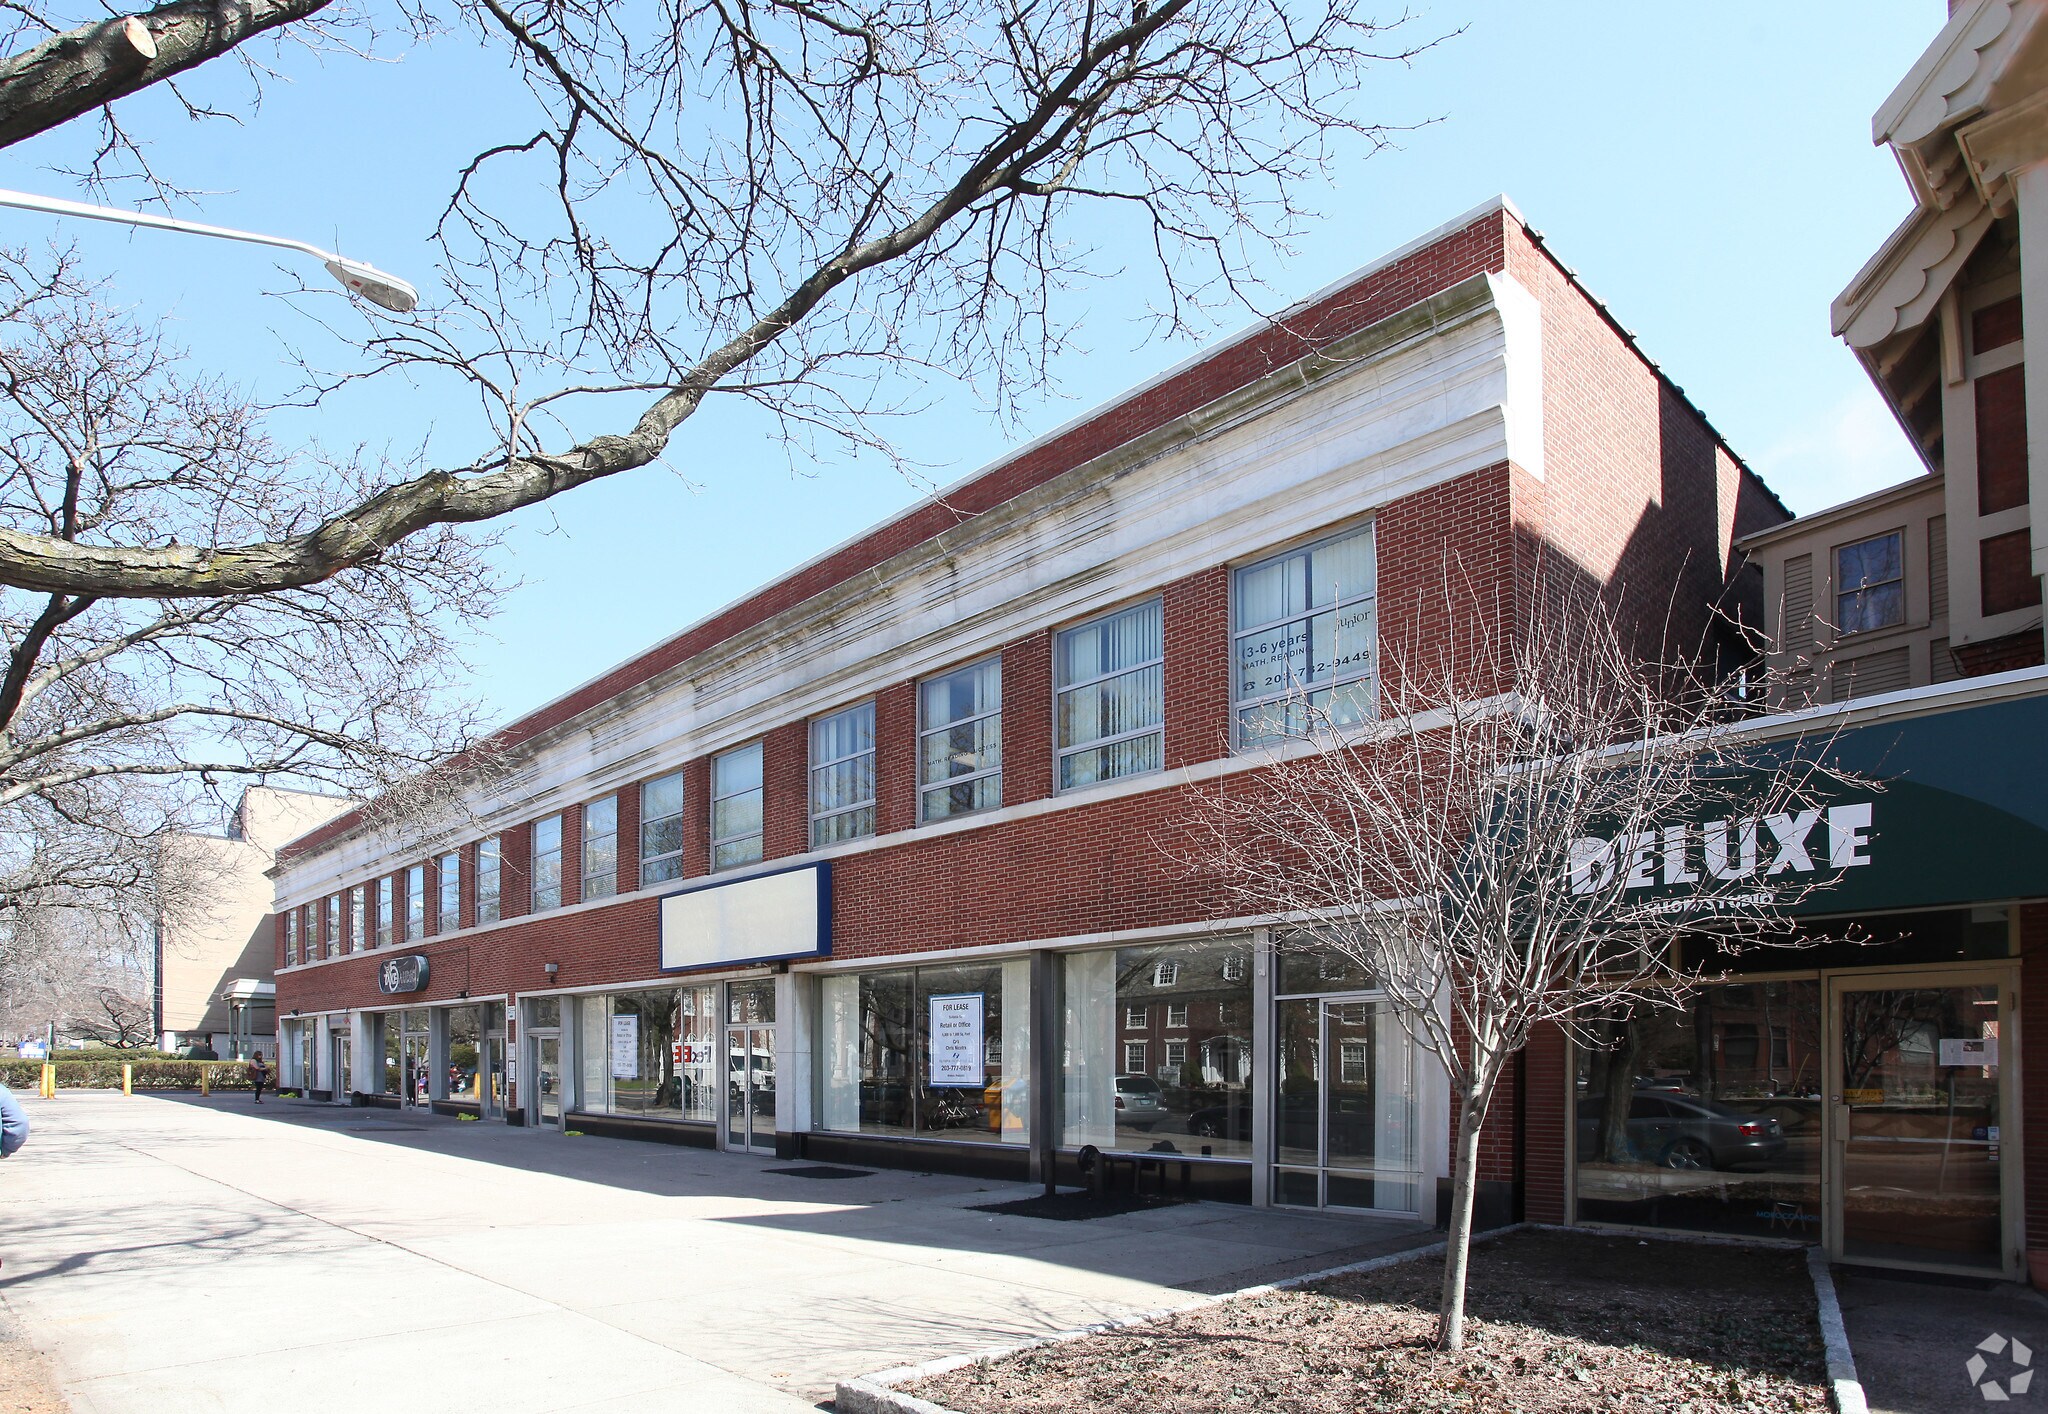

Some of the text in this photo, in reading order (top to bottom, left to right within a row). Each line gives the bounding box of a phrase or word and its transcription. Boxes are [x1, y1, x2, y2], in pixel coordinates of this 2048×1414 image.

[1334, 611, 1371, 632] junior
[1242, 642, 1268, 660] (3-6
[1569, 802, 1872, 895] DELUXE
[953, 1003, 969, 1011] LEASE
